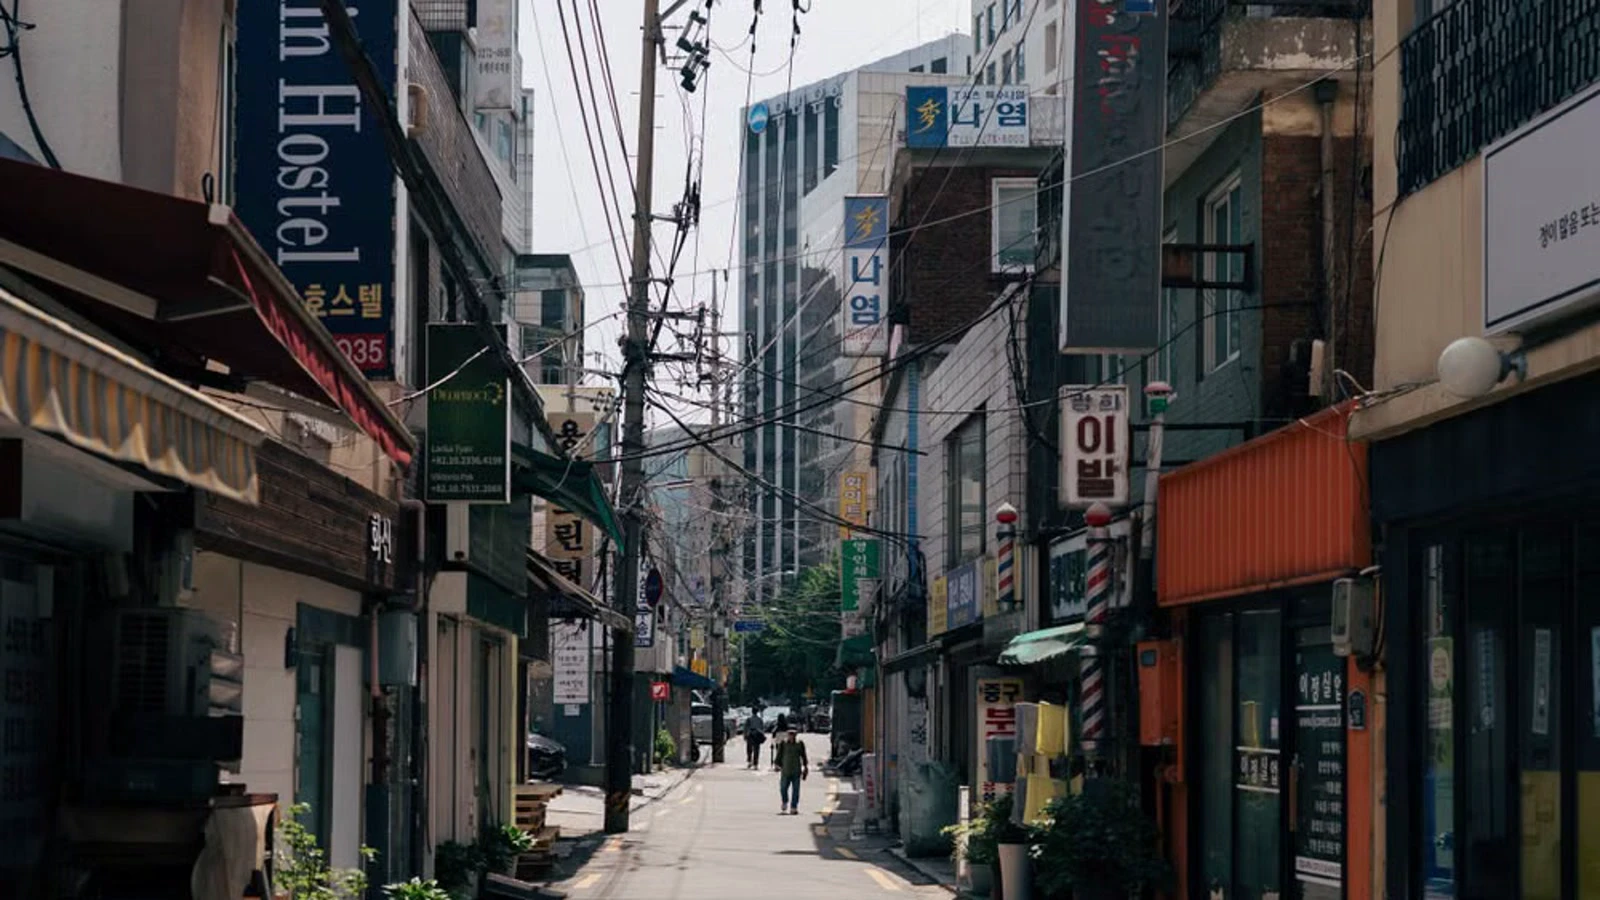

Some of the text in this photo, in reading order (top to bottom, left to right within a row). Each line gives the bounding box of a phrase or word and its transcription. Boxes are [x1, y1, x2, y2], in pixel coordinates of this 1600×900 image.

[951, 101, 1026, 128] 나염
[276, 78, 361, 266] Hostel
[304, 283, 382, 318] 호스텔
[850, 255, 884, 325] 나염
[1078, 415, 1121, 498] 이발
